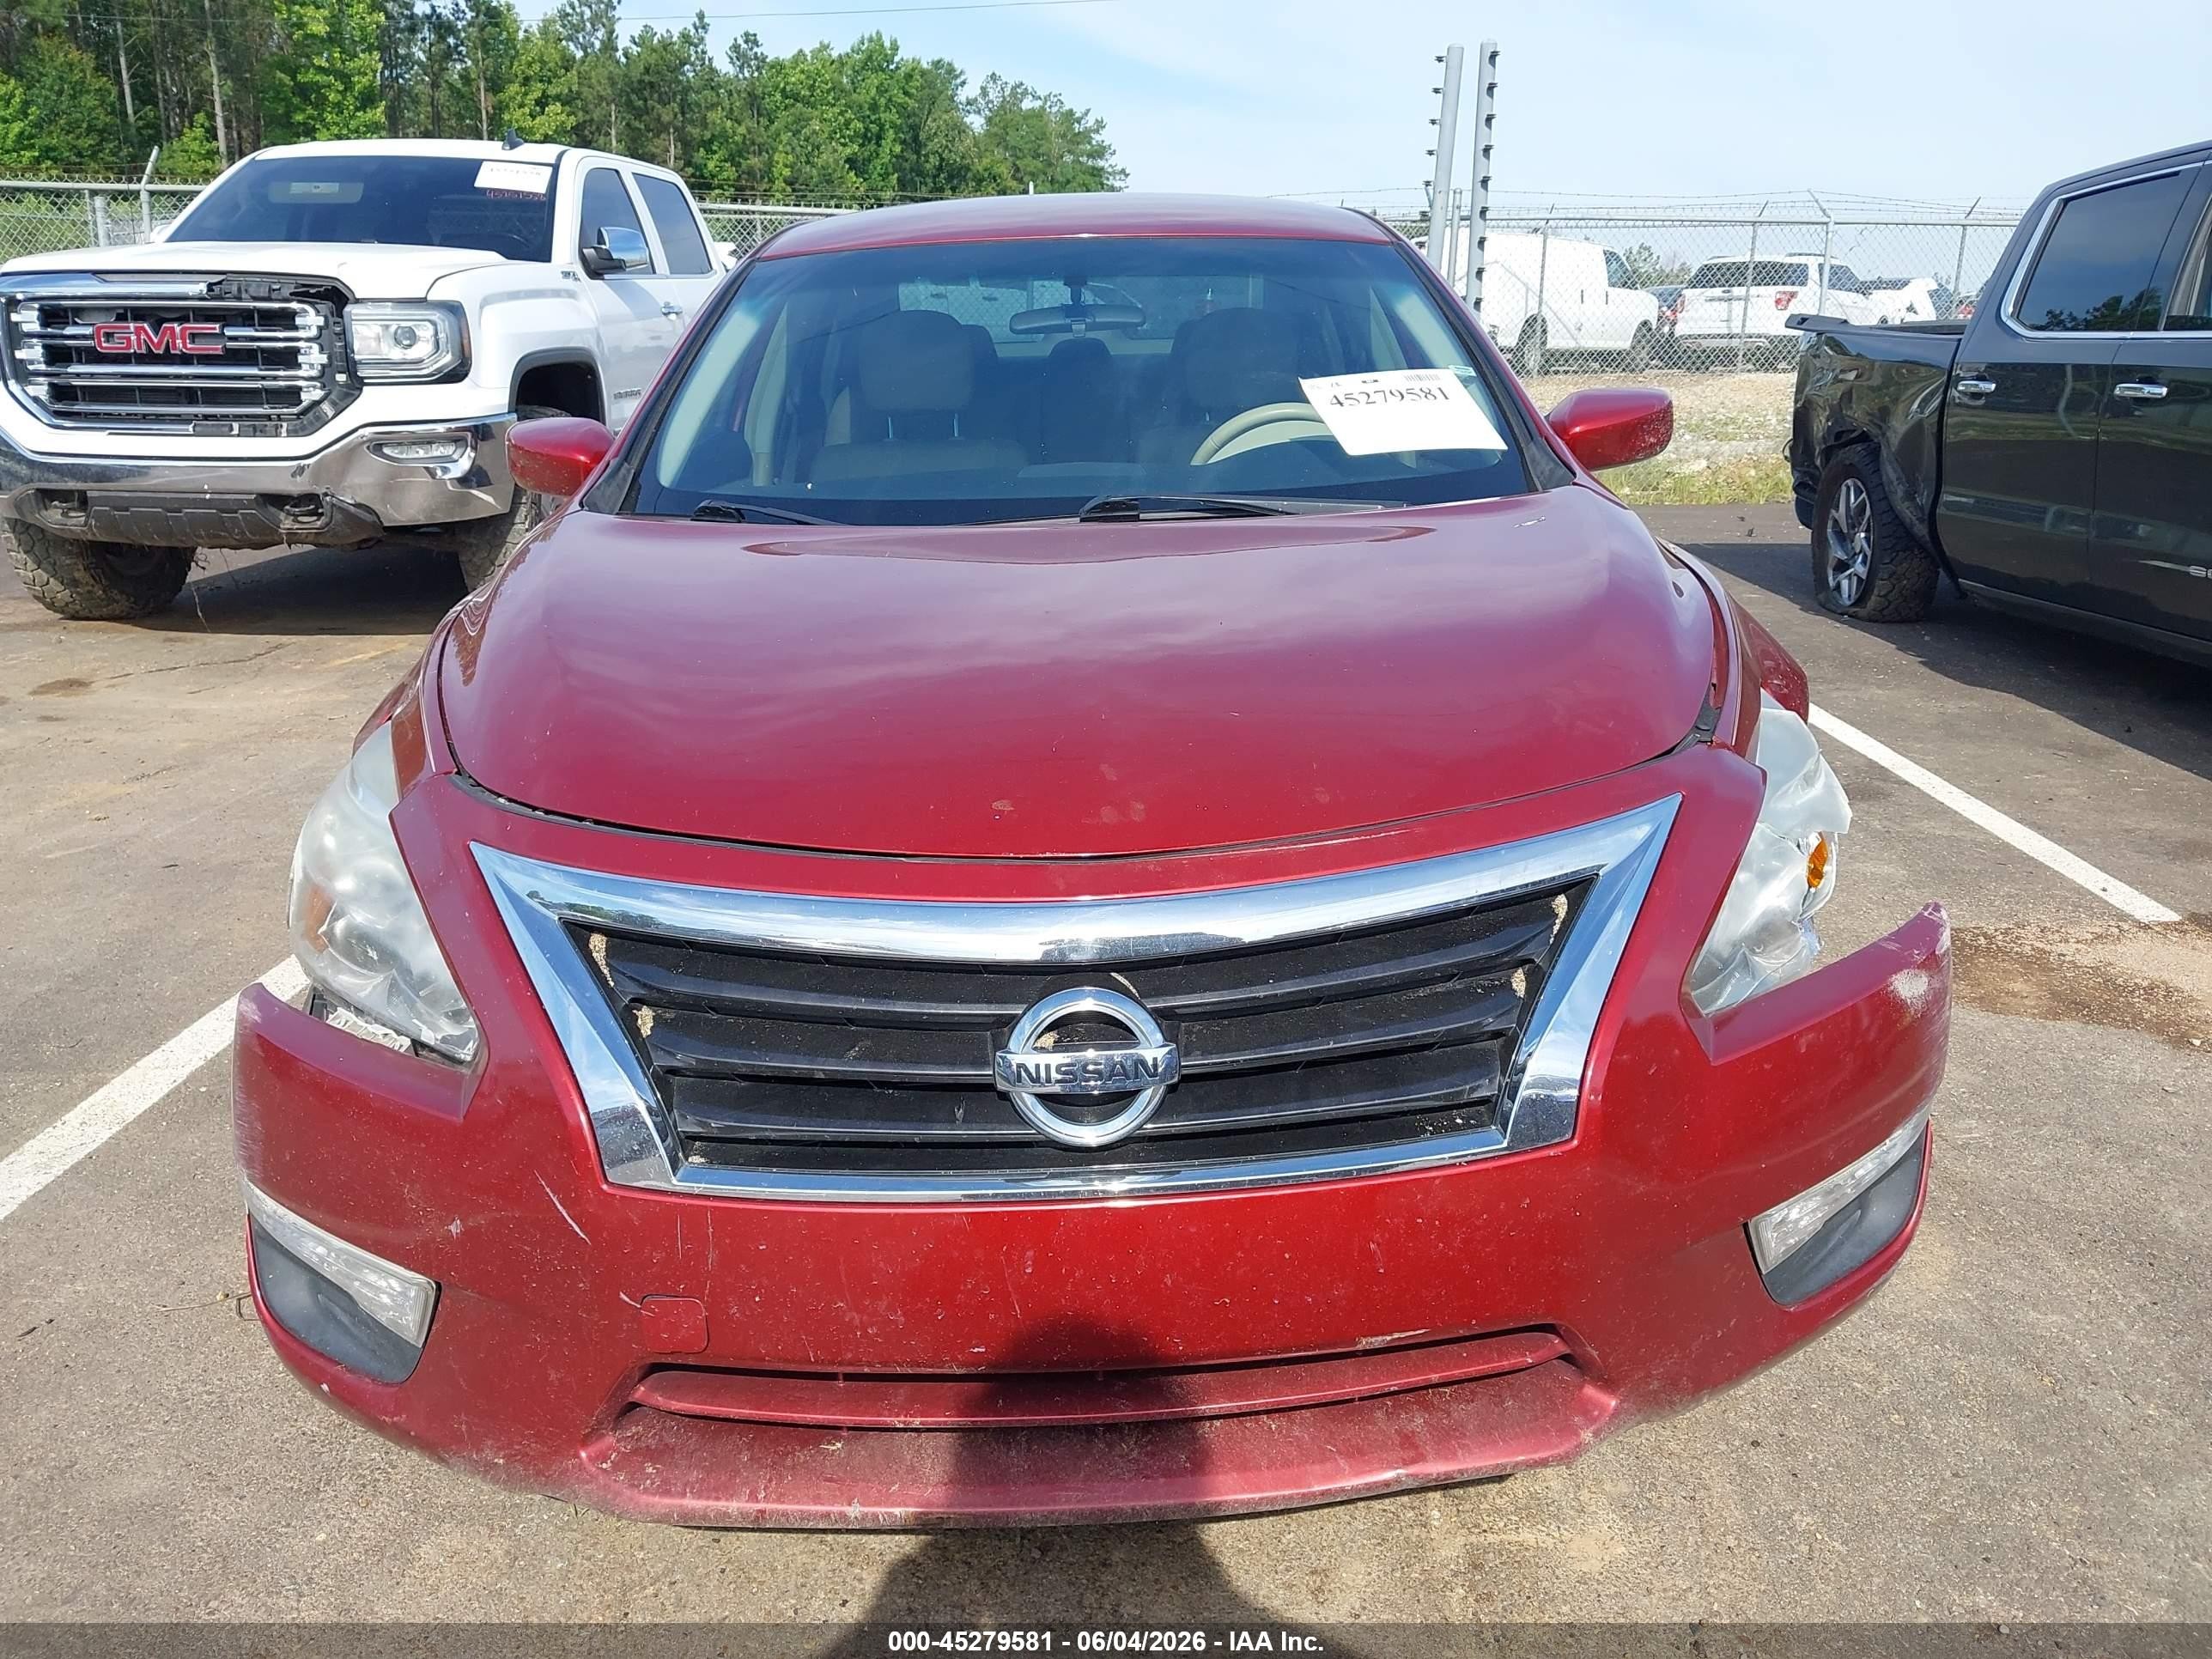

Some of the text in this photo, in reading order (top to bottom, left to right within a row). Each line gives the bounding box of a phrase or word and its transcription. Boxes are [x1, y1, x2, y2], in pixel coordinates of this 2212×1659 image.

[94, 322, 225, 355] GMC
[1329, 386, 1450, 408] 45279581
[1014, 1056, 1159, 1086] NISSAN
